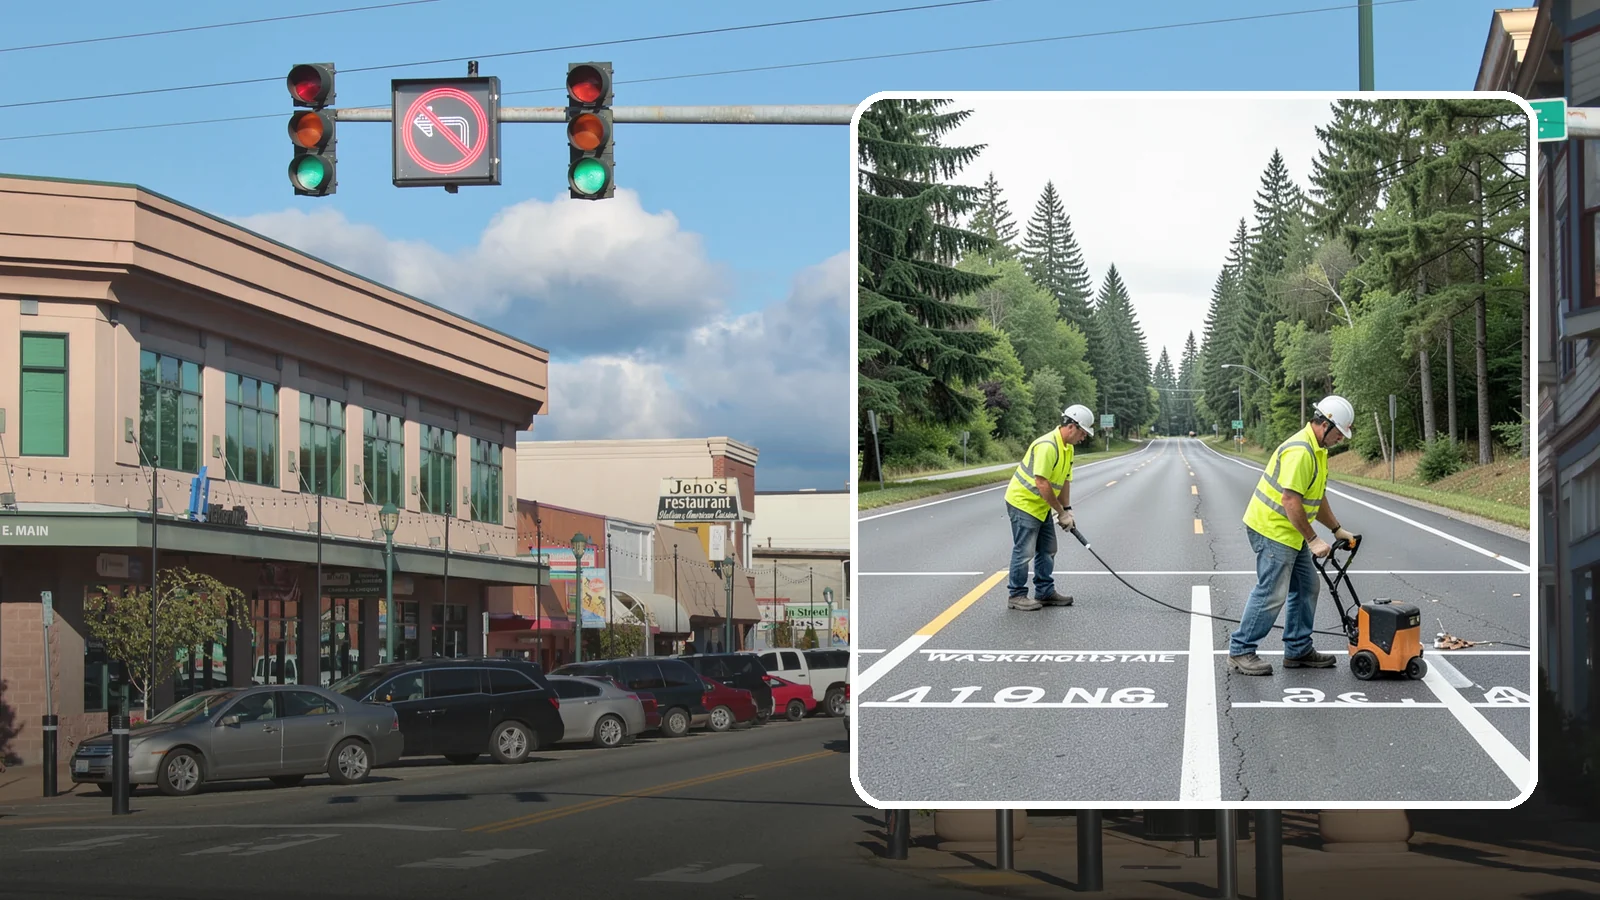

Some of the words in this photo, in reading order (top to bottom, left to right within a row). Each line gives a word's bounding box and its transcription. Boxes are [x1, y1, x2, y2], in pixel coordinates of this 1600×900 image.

[670, 480, 727, 494] Jeno's
[665, 496, 731, 509] restaurant
[685, 509, 714, 519] American
[2, 525, 13, 536] E.
[15, 525, 49, 536] MAIN
[797, 607, 829, 617] Street
